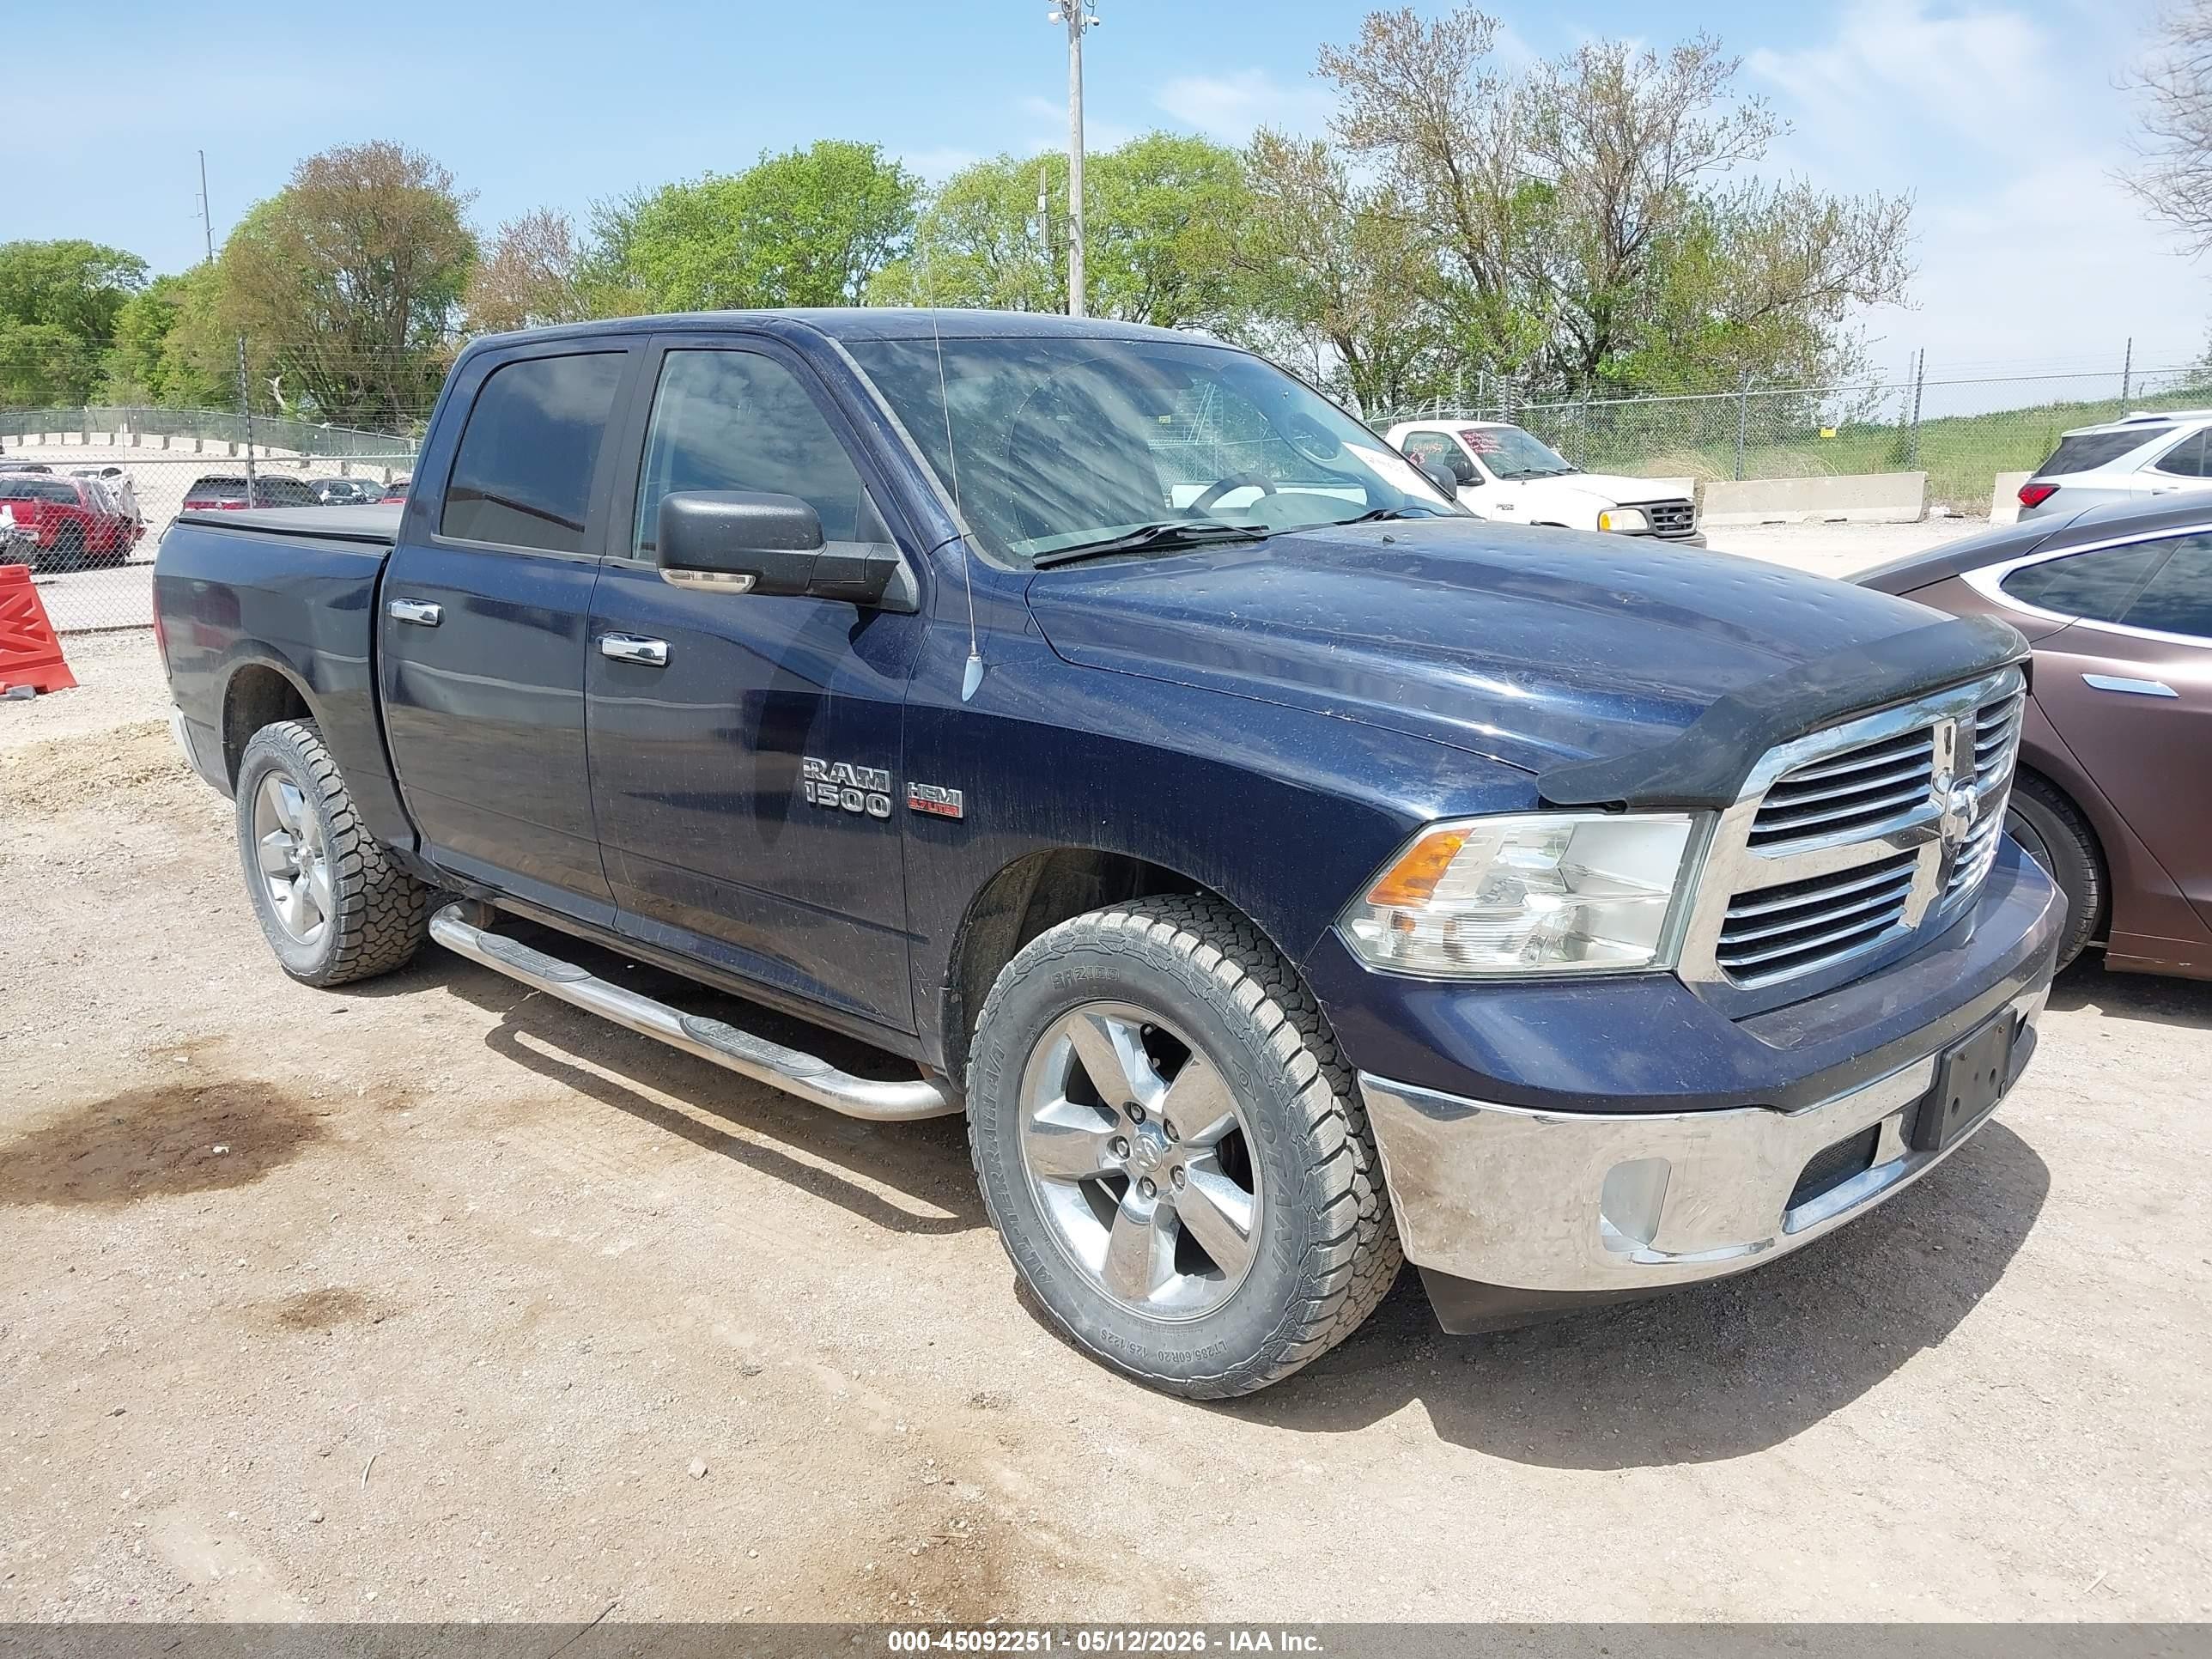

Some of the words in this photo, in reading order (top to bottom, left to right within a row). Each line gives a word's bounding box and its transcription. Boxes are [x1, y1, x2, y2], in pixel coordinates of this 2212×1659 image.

[803, 756, 890, 793] RAM
[804, 781, 891, 818] 1500
[907, 781, 963, 806] HEMI
[908, 798, 926, 811] 5.7
[927, 801, 961, 817] LITER
[981, 1094, 1054, 1285] ALL-TERRAIN
[1157, 1339, 1228, 1363] LT285/60R20
